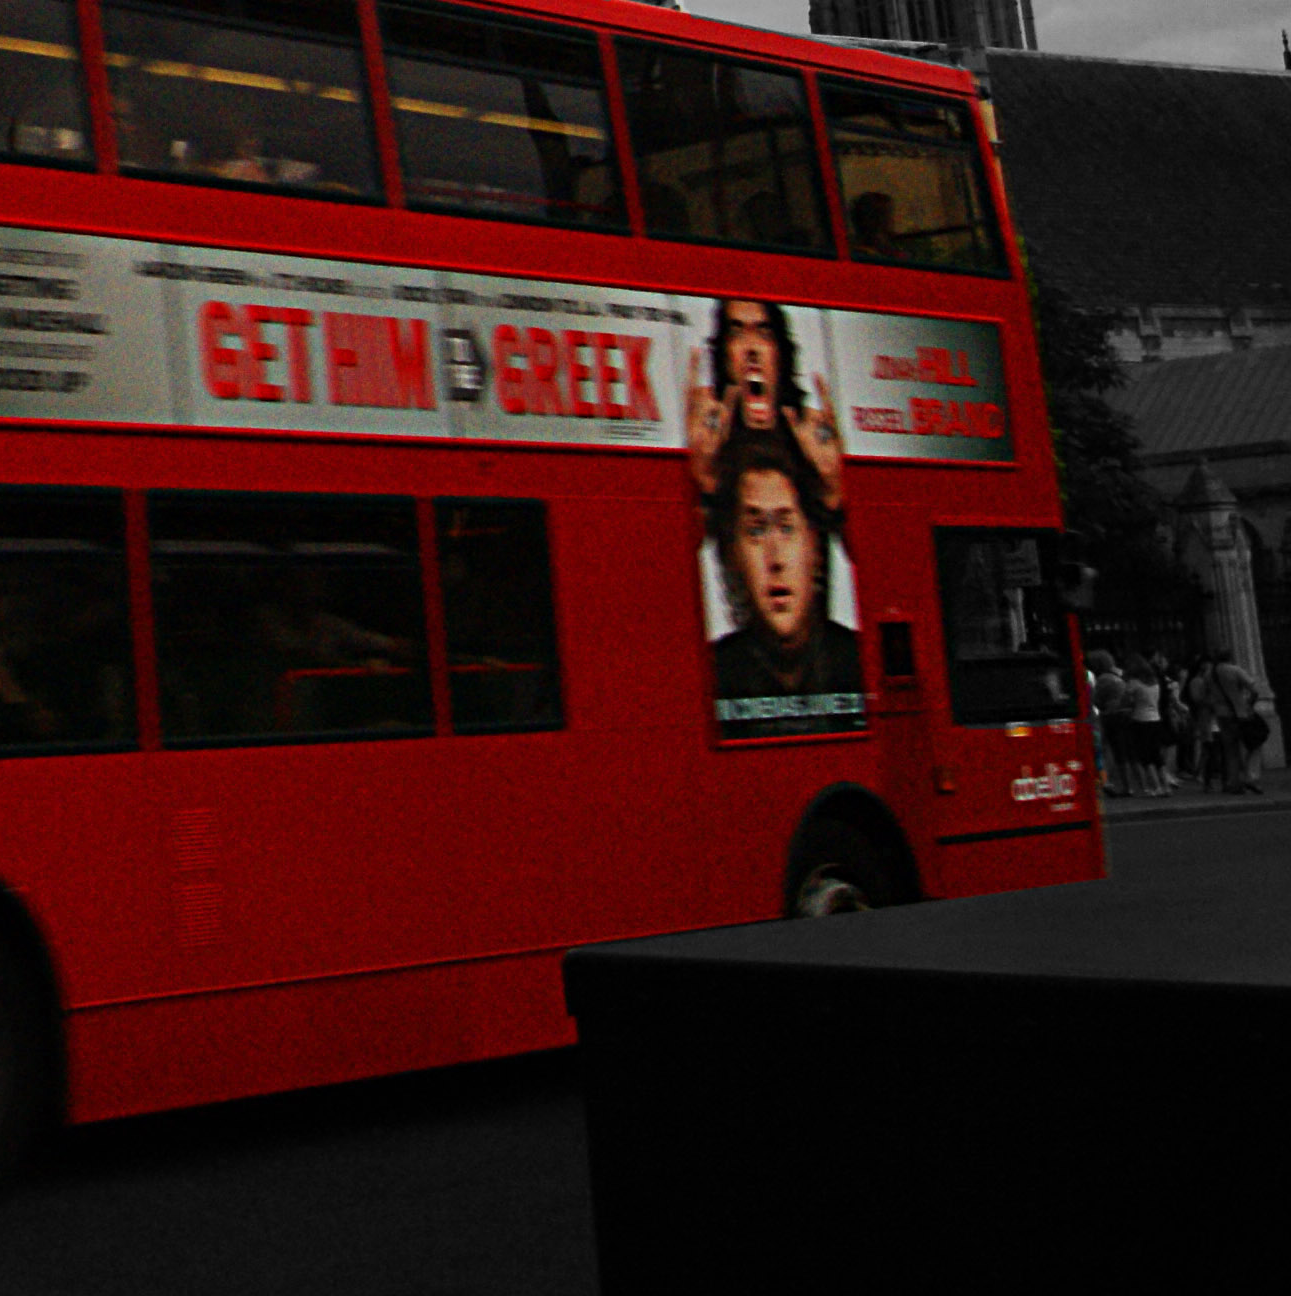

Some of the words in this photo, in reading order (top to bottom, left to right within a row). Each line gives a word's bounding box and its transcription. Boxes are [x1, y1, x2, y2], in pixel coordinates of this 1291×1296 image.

[197, 299, 315, 405] GET
[321, 311, 437, 410] HIM
[491, 323, 663, 423] GREEK
